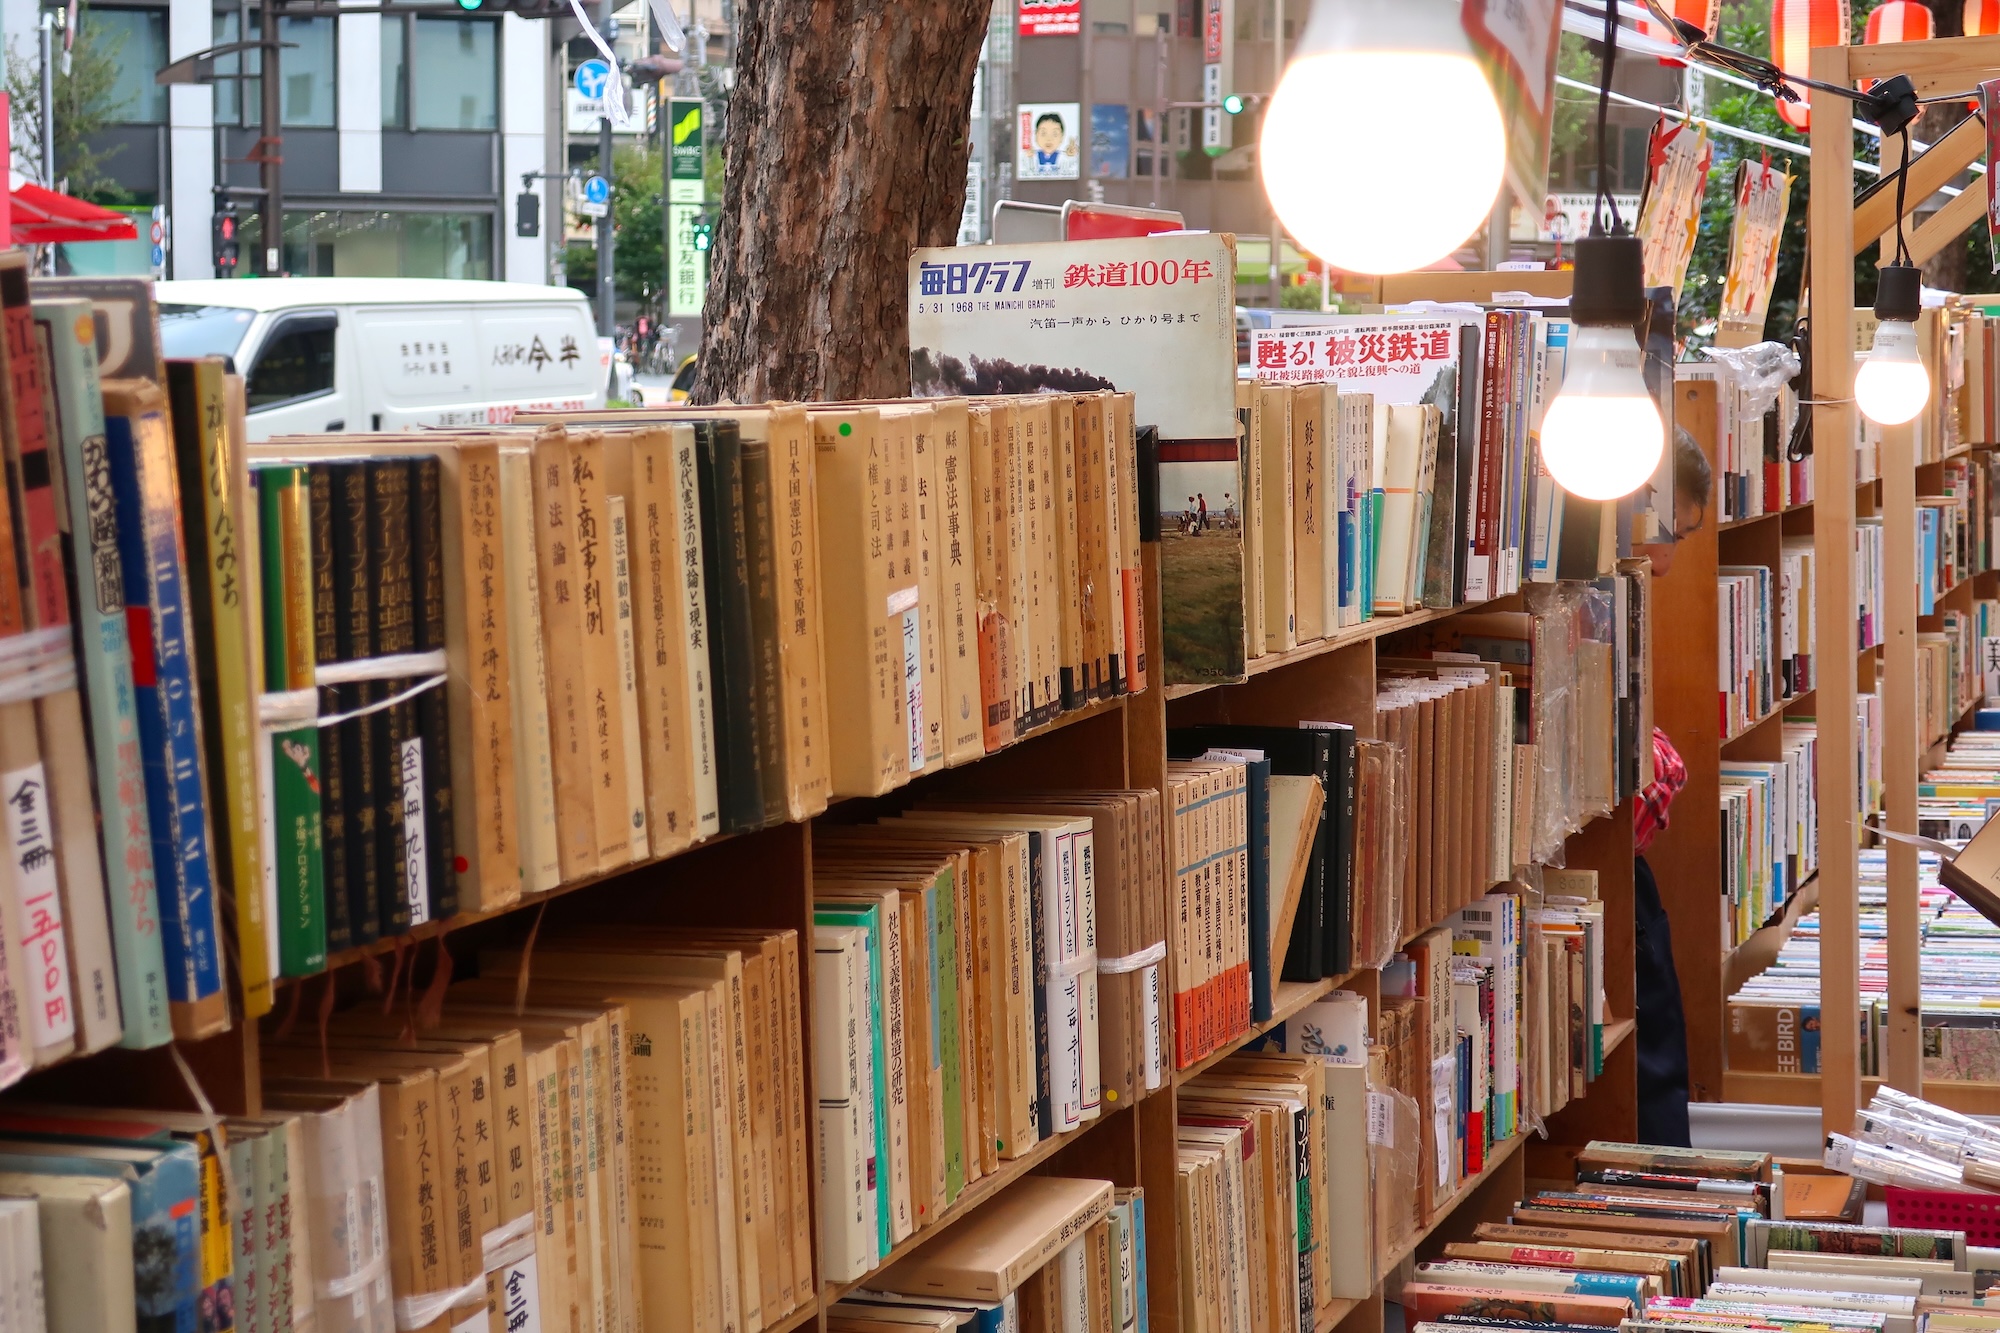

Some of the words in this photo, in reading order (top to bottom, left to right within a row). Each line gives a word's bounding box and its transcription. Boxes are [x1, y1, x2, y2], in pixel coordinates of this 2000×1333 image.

[678, 188, 697, 306] 三井住友銀行
[918, 302, 944, 313] 5/31
[951, 301, 973, 313] 1968
[978, 301, 990, 311] THE
[994, 300, 1024, 311] MAINICHI
[1028, 299, 1056, 310] GRAPHIC
[919, 260, 1031, 296] 毎日グラフ
[1032, 277, 1055, 290] 増刊
[1063, 258, 1214, 289] 鉄道100年
[1030, 316, 1112, 329] 汽笛一声から
[1120, 312, 1201, 326] ひかり号まで
[1256, 340, 1314, 369] 甦る!
[1325, 331, 1451, 367] 被災鉄道
[1256, 363, 1421, 382] 東北被災路線の全貌と復興への道
[84, 441, 119, 543] かわら版
[545, 462, 570, 605] 商法論集
[571, 457, 603, 635] 私と商事判例
[678, 447, 703, 651] 現代憲法の理論と現実
[787, 438, 808, 638] 日本国憲法の平等原理
[867, 435, 883, 559] 人権と司法
[883, 476, 896, 581] 憲法講義
[900, 475, 912, 577] 憲法講義
[944, 454, 962, 565] 憲法事典
[477, 540, 502, 702] 商事法の研究
[612, 515, 631, 620] 憲法運動論
[646, 501, 667, 668] 現代政治の思想と行動
[977, 871, 989, 974] 憲法学要論
[1007, 865, 1021, 996] 現代憲法の基本問題
[730, 974, 748, 1139] 教科書裁判と憲法学
[750, 984, 767, 1118] 憲法判例の体系
[767, 955, 785, 1139] アメリカ憲法の現代的展開
[787, 949, 802, 1134] アメリカ憲法の現代的展開
[847, 1018, 859, 1096] 憲法判例
[886, 911, 906, 1104] 社会主義憲法構造の研究
[1777, 1008, 1795, 1052] BIRD
[413, 1099, 438, 1270] キリスト教の源流
[446, 1084, 473, 1254] キリスト教の展開
[536, 1077, 555, 1236] 現代国際政治の基本問題
[547, 1072, 564, 1203] 国連と日本外交
[568, 1064, 585, 1199] 平和と戦争の研究
[1297, 1113, 1313, 1252] リアル国家論
